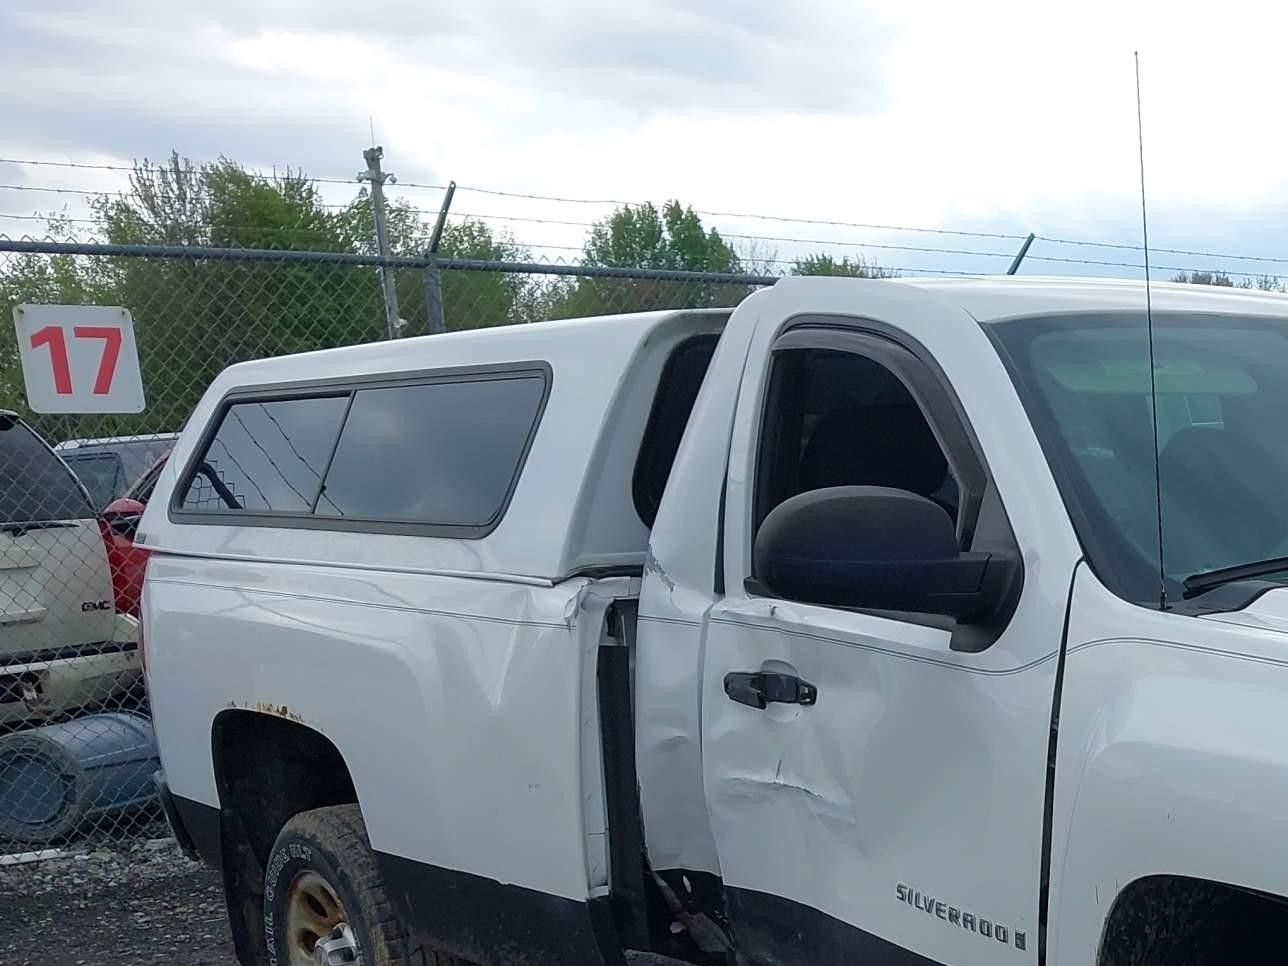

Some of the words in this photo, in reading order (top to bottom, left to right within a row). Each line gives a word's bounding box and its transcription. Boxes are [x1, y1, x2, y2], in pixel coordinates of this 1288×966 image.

[29, 325, 123, 395] 17
[82, 600, 112, 612] GMC
[266, 847, 291, 902] GUIDE
[896, 882, 1009, 944] SILVERADO
